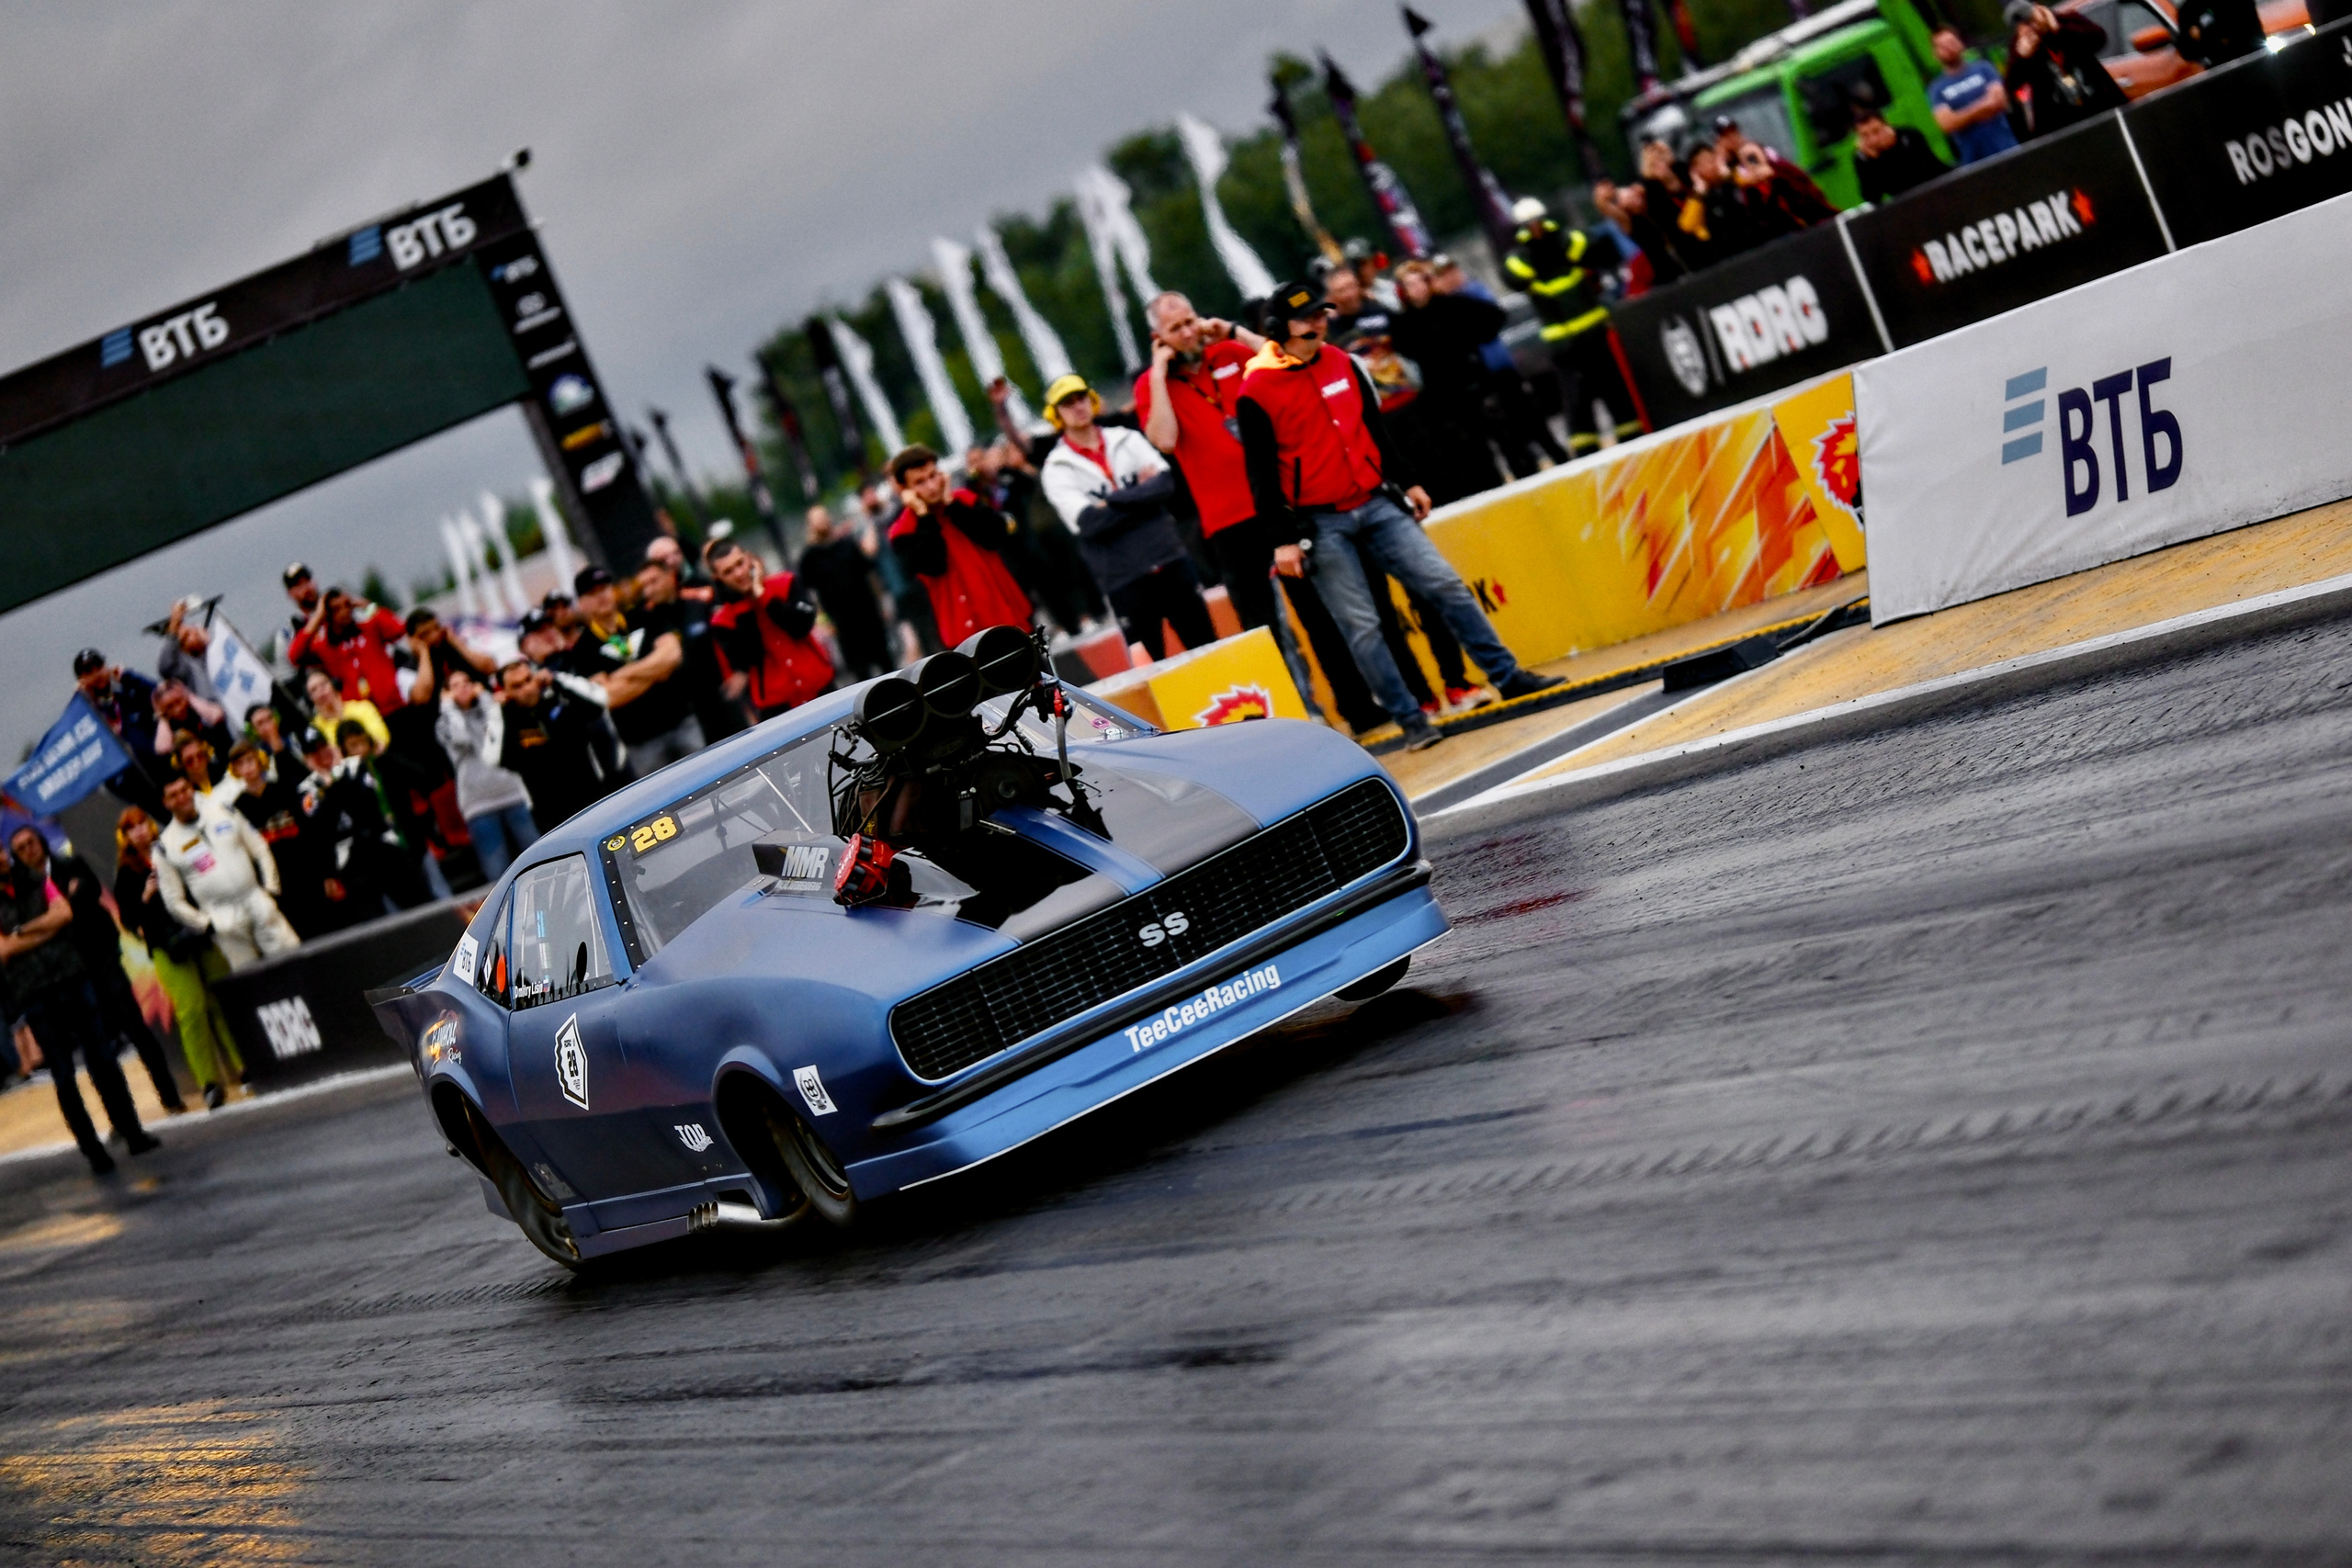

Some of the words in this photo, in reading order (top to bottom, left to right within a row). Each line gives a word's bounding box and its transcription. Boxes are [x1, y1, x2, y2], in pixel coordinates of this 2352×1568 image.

[385, 201, 478, 271] ВТБ
[1922, 189, 2083, 284] RACEPARK
[138, 301, 231, 372] ВТБ
[2057, 355, 2184, 518] ВТБ
[630, 816, 678, 853] 28
[782, 845, 830, 879] MMR
[1138, 911, 1190, 948] SS
[461, 948, 472, 974] ВТБ
[514, 984, 531, 998] Dmitry
[1124, 964, 1282, 1053] TeeCeeRacing
[447, 1047, 462, 1066] Racing
[567, 1049, 580, 1077] 28
[673, 1123, 707, 1148] TOP
